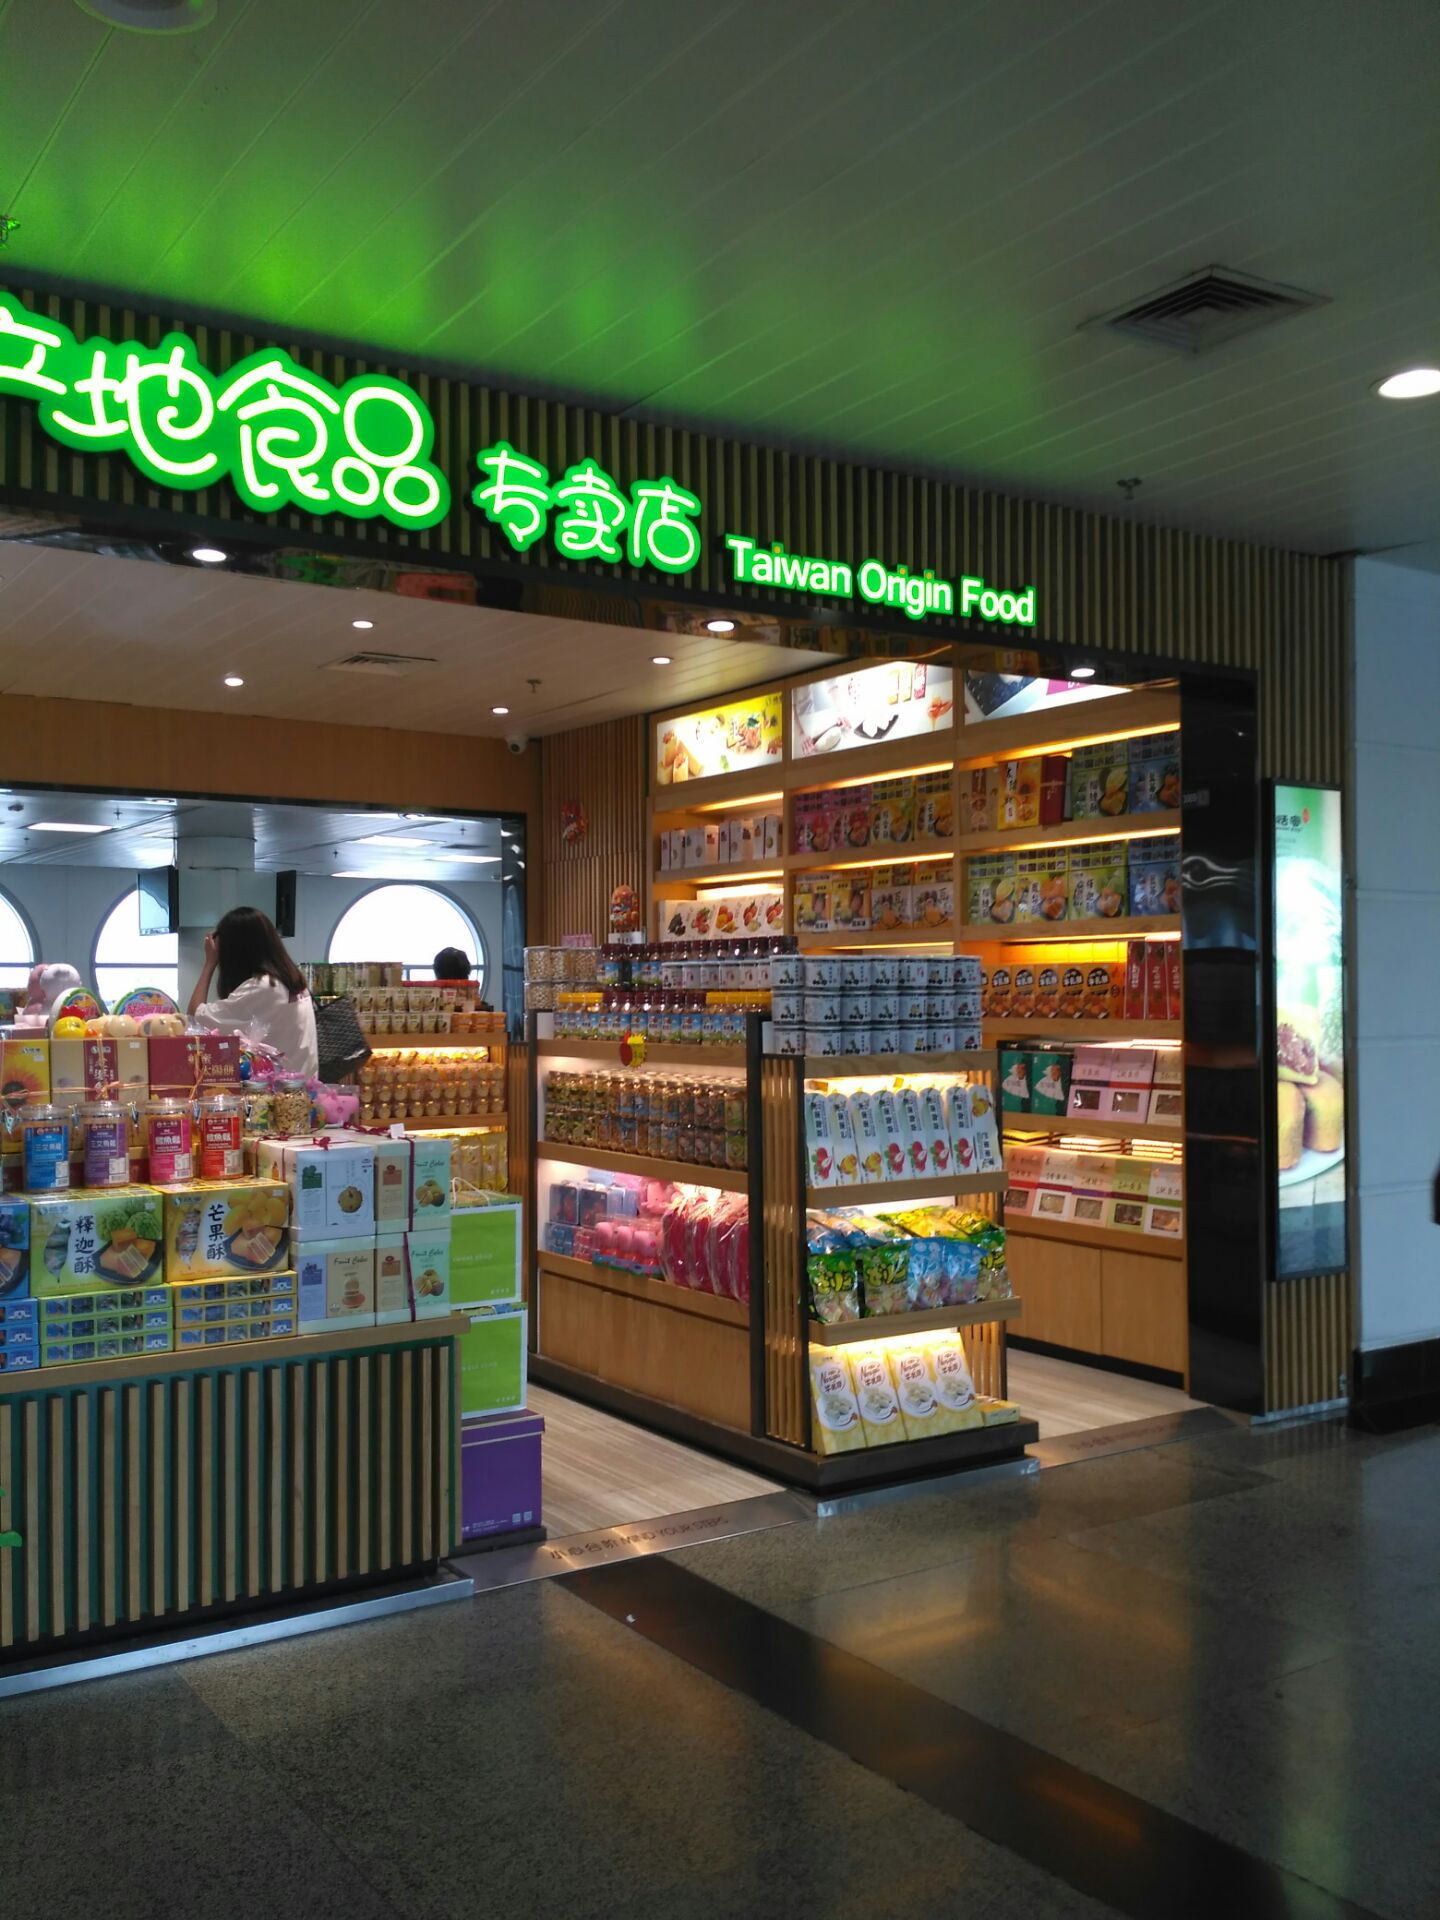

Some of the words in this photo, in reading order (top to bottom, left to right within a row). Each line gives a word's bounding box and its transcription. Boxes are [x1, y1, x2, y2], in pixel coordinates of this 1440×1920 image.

[477, 448, 698, 567] 专卖店
[727, 537, 851, 594] Taiwan
[860, 560, 951, 616] Origin
[961, 578, 1035, 623] Food
[73, 1215, 95, 1275] 釋迦酥
[206, 1203, 229, 1261] 芒果酥
[620, 1532, 656, 1544] MIND
[659, 1523, 692, 1537] YOUR
